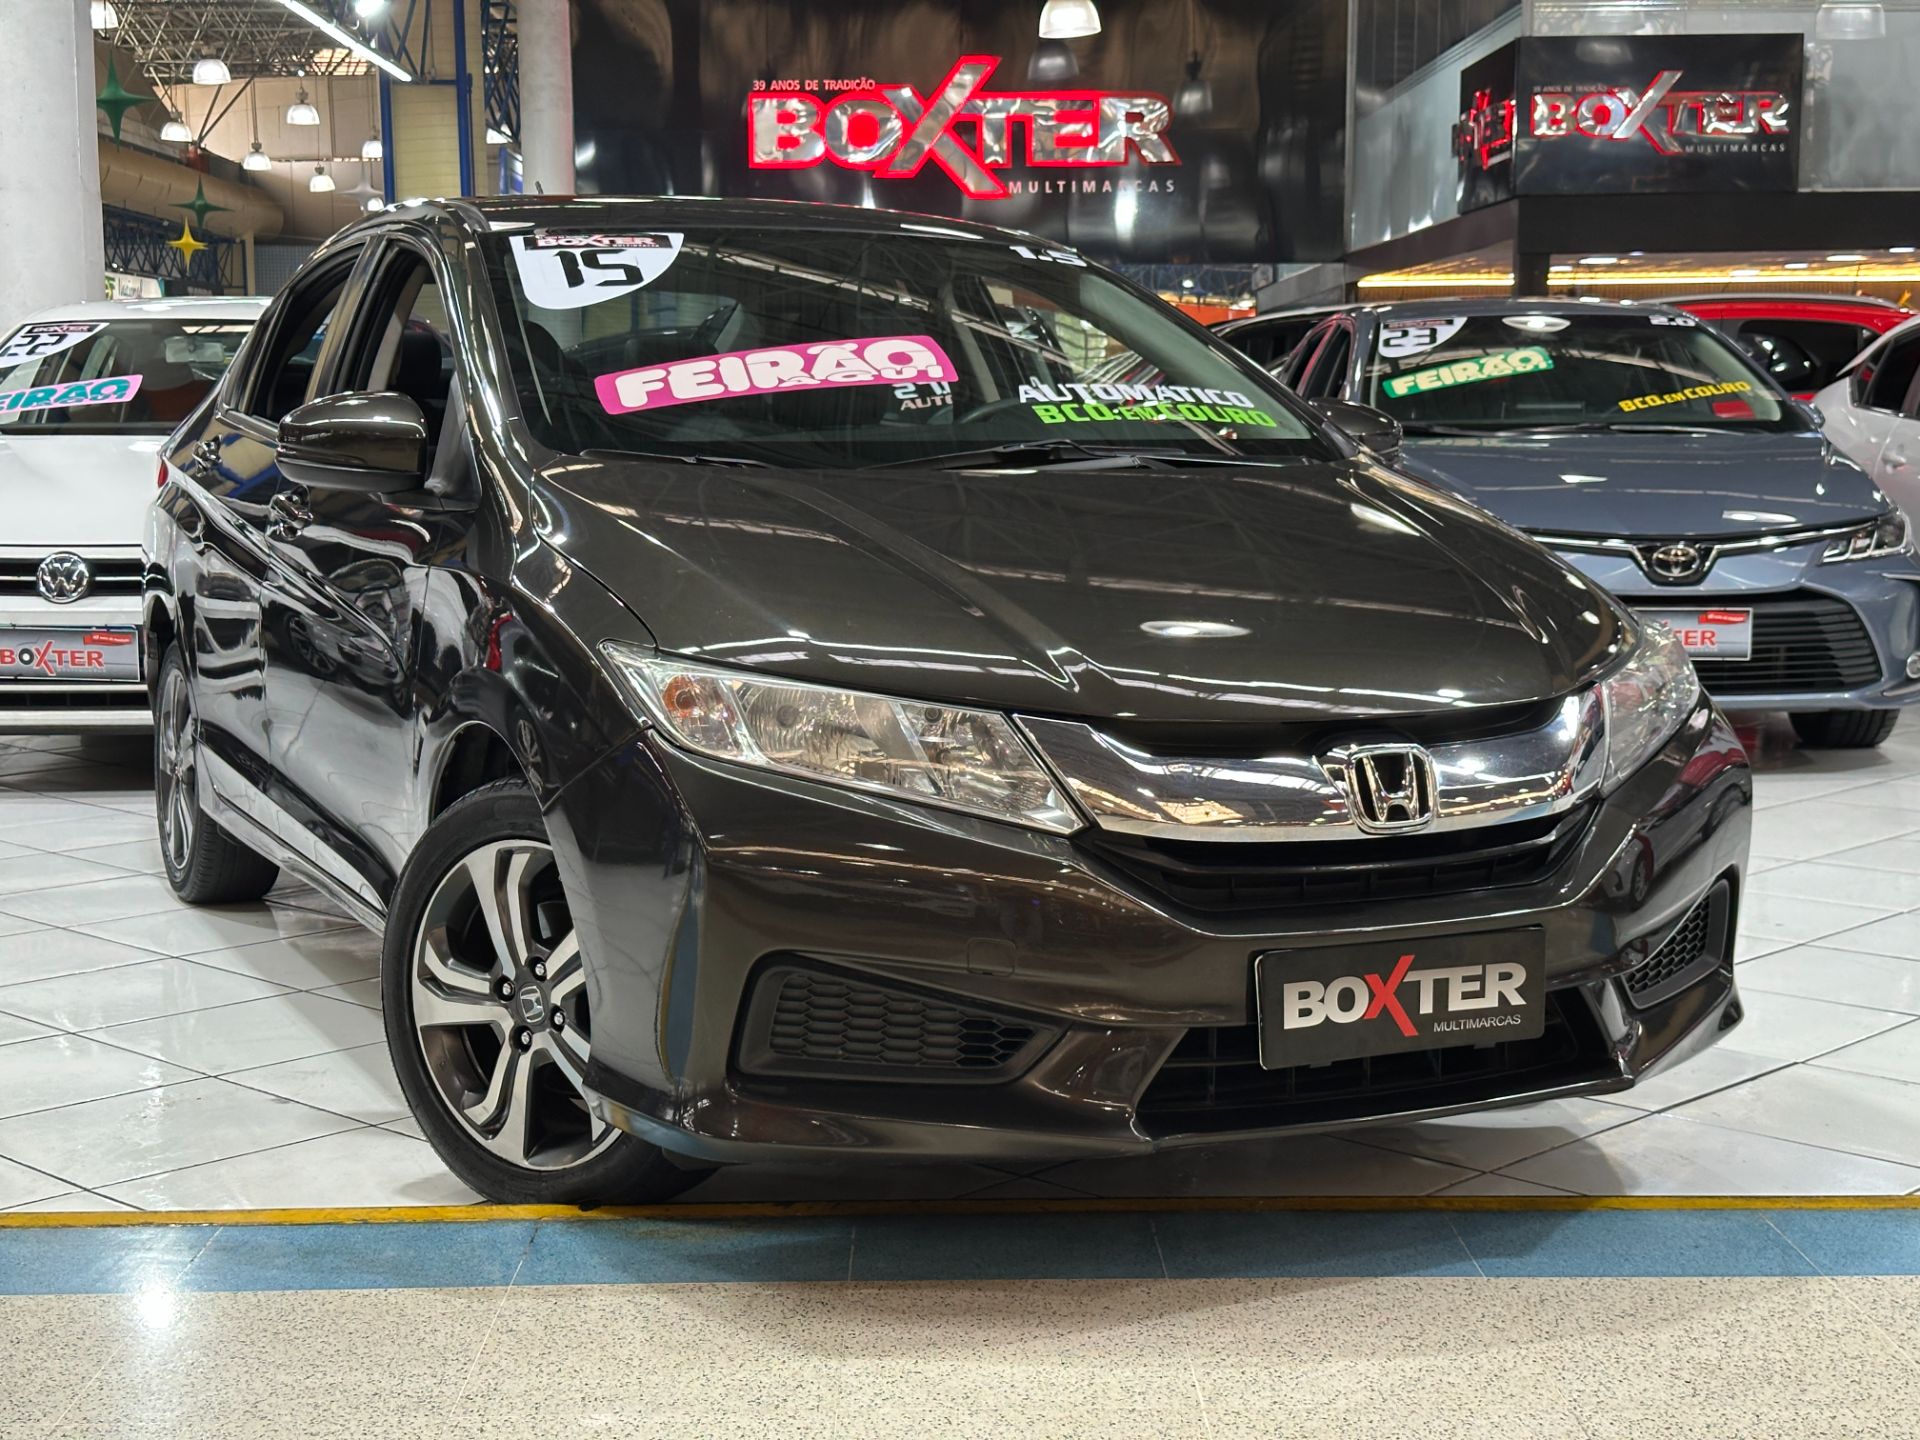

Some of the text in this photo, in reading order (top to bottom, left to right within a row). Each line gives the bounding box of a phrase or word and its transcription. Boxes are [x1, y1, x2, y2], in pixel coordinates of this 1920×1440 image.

[753, 77, 876, 92] 39 ANOS DE TRADIÇÃO
[1531, 70, 1790, 156] BOXTER
[747, 55, 1181, 199] BOXTER
[1685, 143, 1785, 153] MULTIMARCAS
[1008, 179, 1175, 194] MULTIMARCAS
[1009, 246, 1088, 267] 1.5
[553, 249, 645, 288] 15
[1649, 314, 1696, 327] 2.0
[1383, 327, 1437, 347] 23
[615, 340, 937, 408] FEIRÃO
[1391, 350, 1547, 395] FEIRÃO
[1683, 381, 1751, 399] COURO
[1157, 403, 1278, 428] COURO
[1283, 955, 1527, 1037] BOXTER
[1433, 1014, 1521, 1032] MULTIMARCAS
